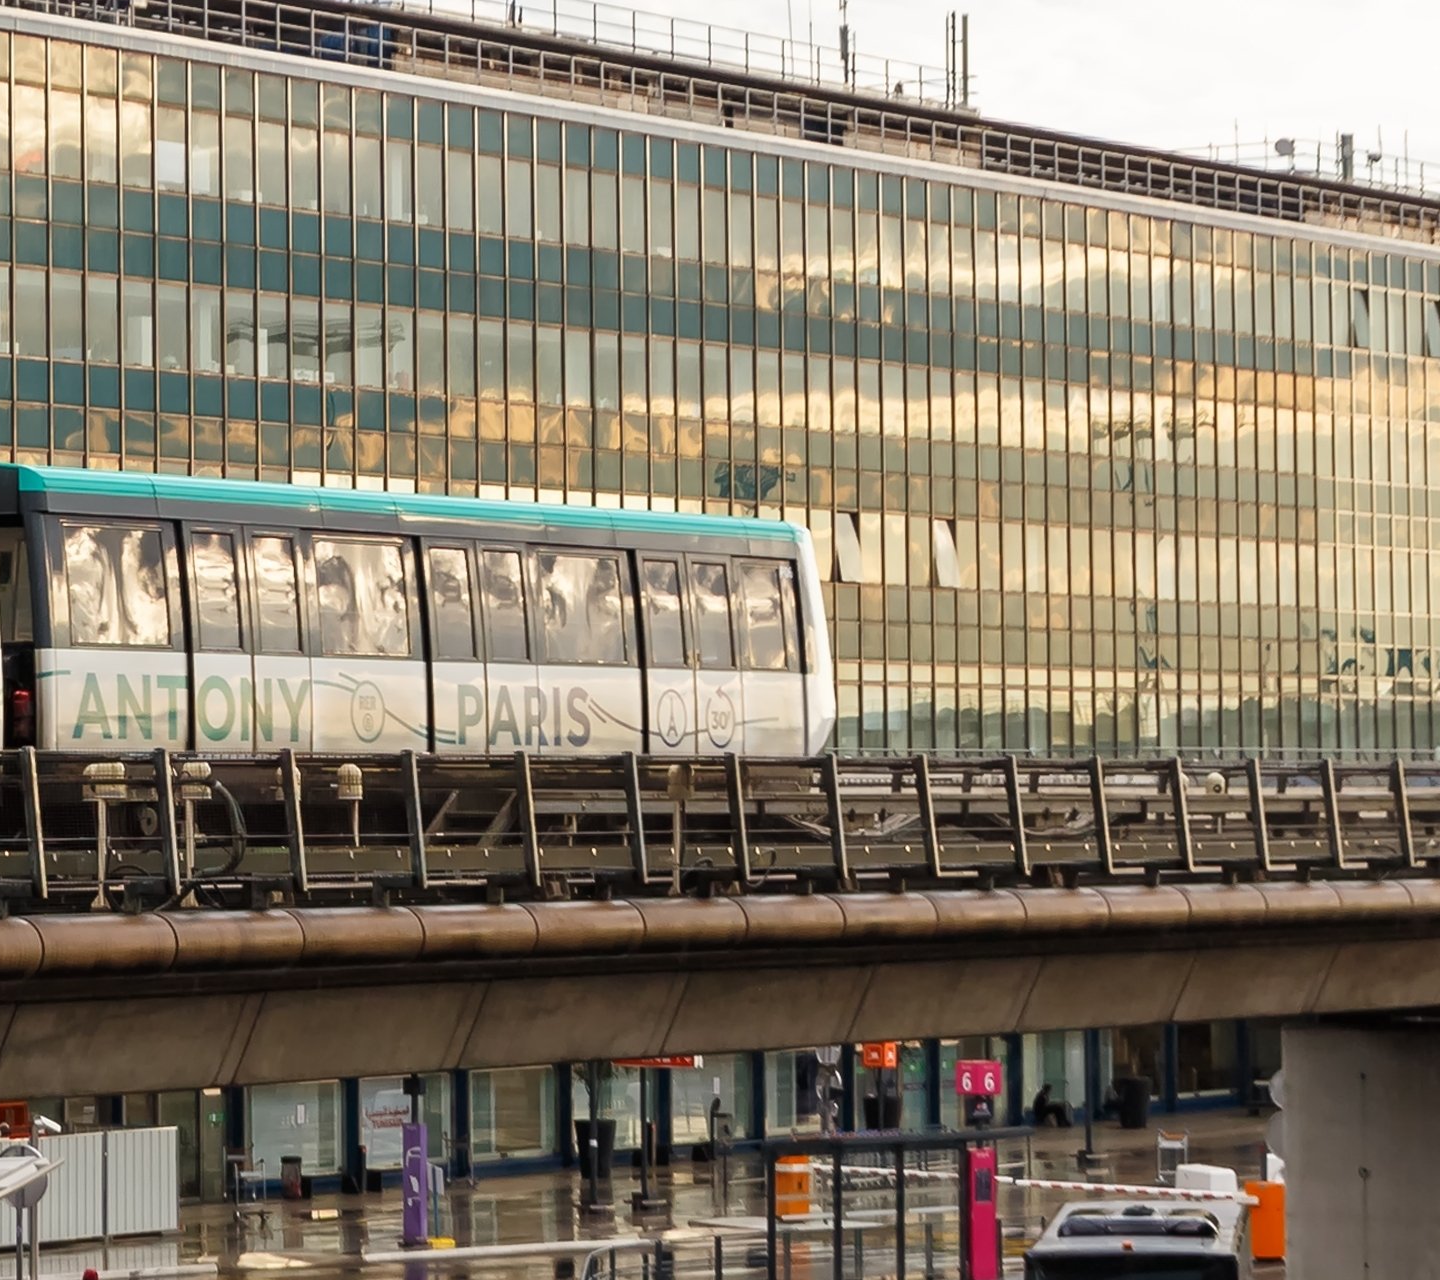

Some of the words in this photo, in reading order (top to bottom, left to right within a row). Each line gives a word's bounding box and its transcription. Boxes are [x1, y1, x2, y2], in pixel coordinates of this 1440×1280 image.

[72, 672, 311, 742] ANTONY
[457, 684, 591, 747] PARIS
[962, 1072, 973, 1092] 6
[984, 1072, 995, 1092] 6
